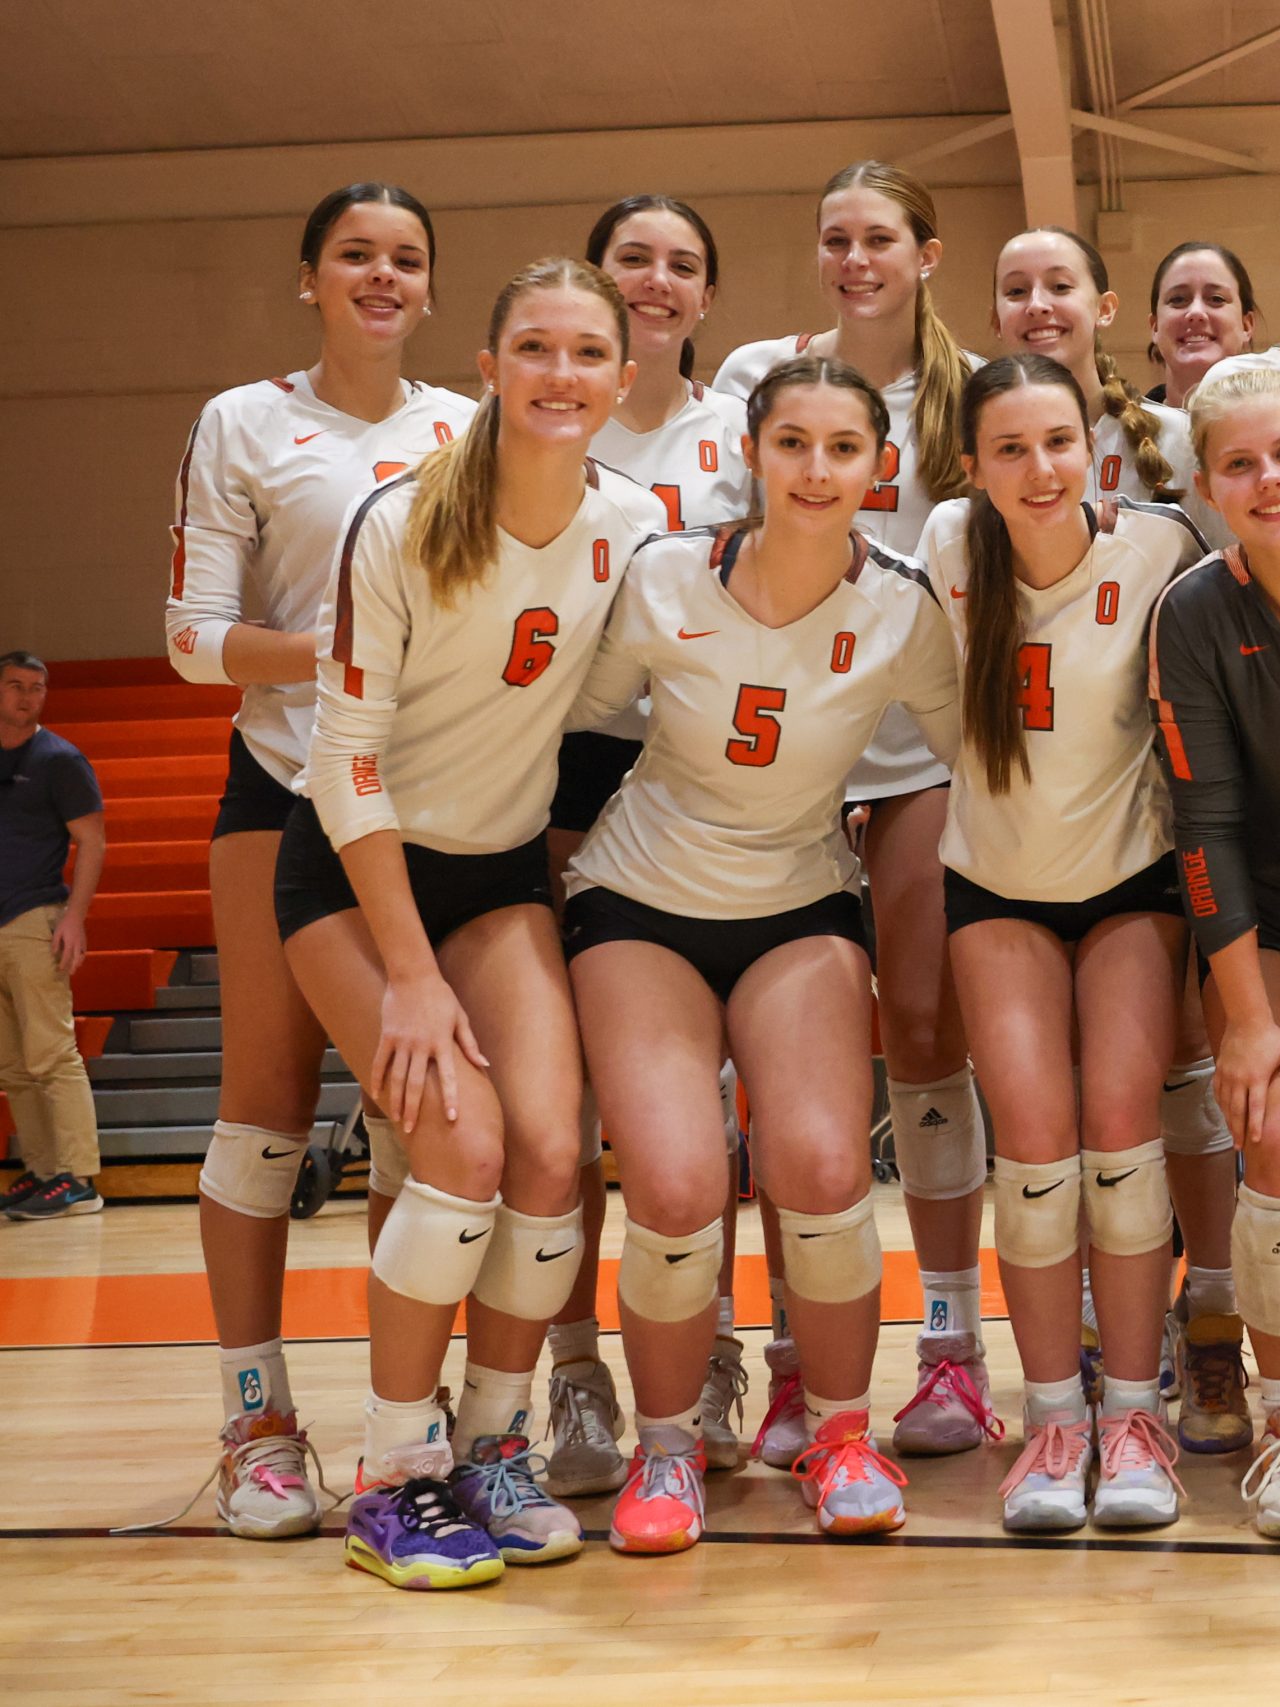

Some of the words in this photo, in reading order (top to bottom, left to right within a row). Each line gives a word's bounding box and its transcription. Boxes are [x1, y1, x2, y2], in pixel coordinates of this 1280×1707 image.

[501, 607, 558, 687] 6
[725, 683, 787, 767] 5
[1183, 846, 1219, 917] ORANGE
